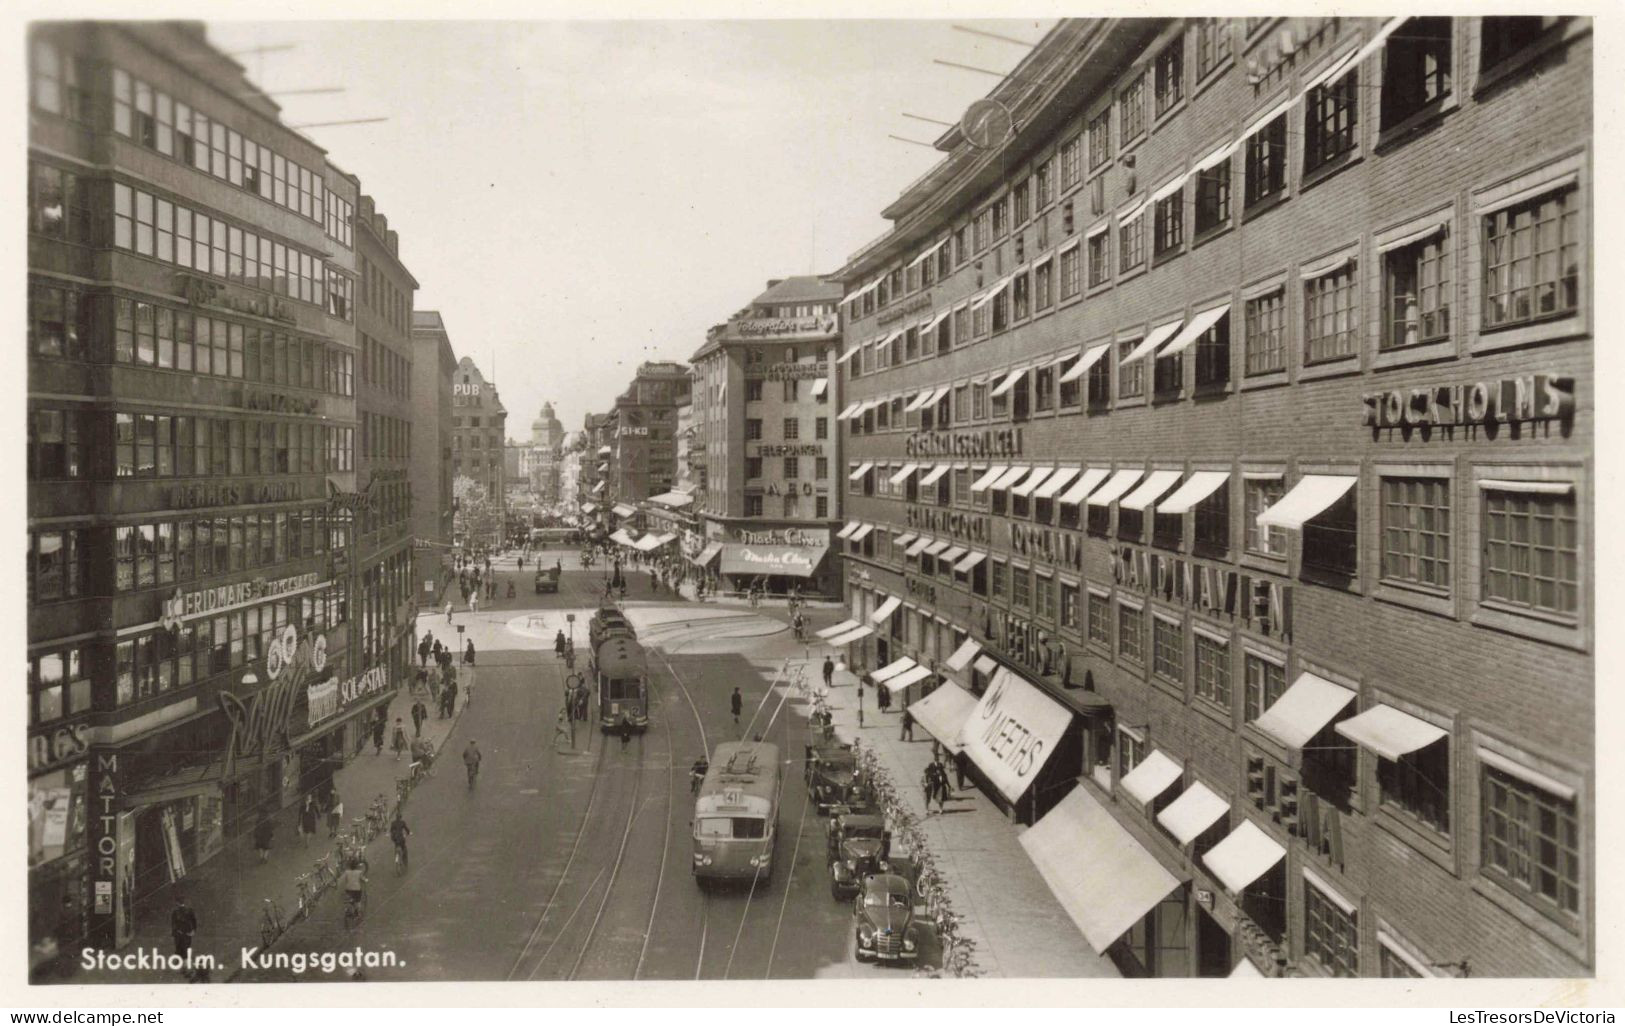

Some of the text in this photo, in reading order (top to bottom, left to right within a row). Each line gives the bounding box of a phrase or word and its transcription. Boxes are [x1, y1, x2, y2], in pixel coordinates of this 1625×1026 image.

[453, 383, 480, 397] PUB
[1362, 373, 1575, 434] STOCKHOLMS
[185, 582, 251, 615] FRIDMANS
[1108, 543, 1293, 640] SKANDINAVIEN
[981, 710, 1043, 778] MEETHS
[98, 754, 117, 876] MATTOR
[726, 791, 738, 804] 41
